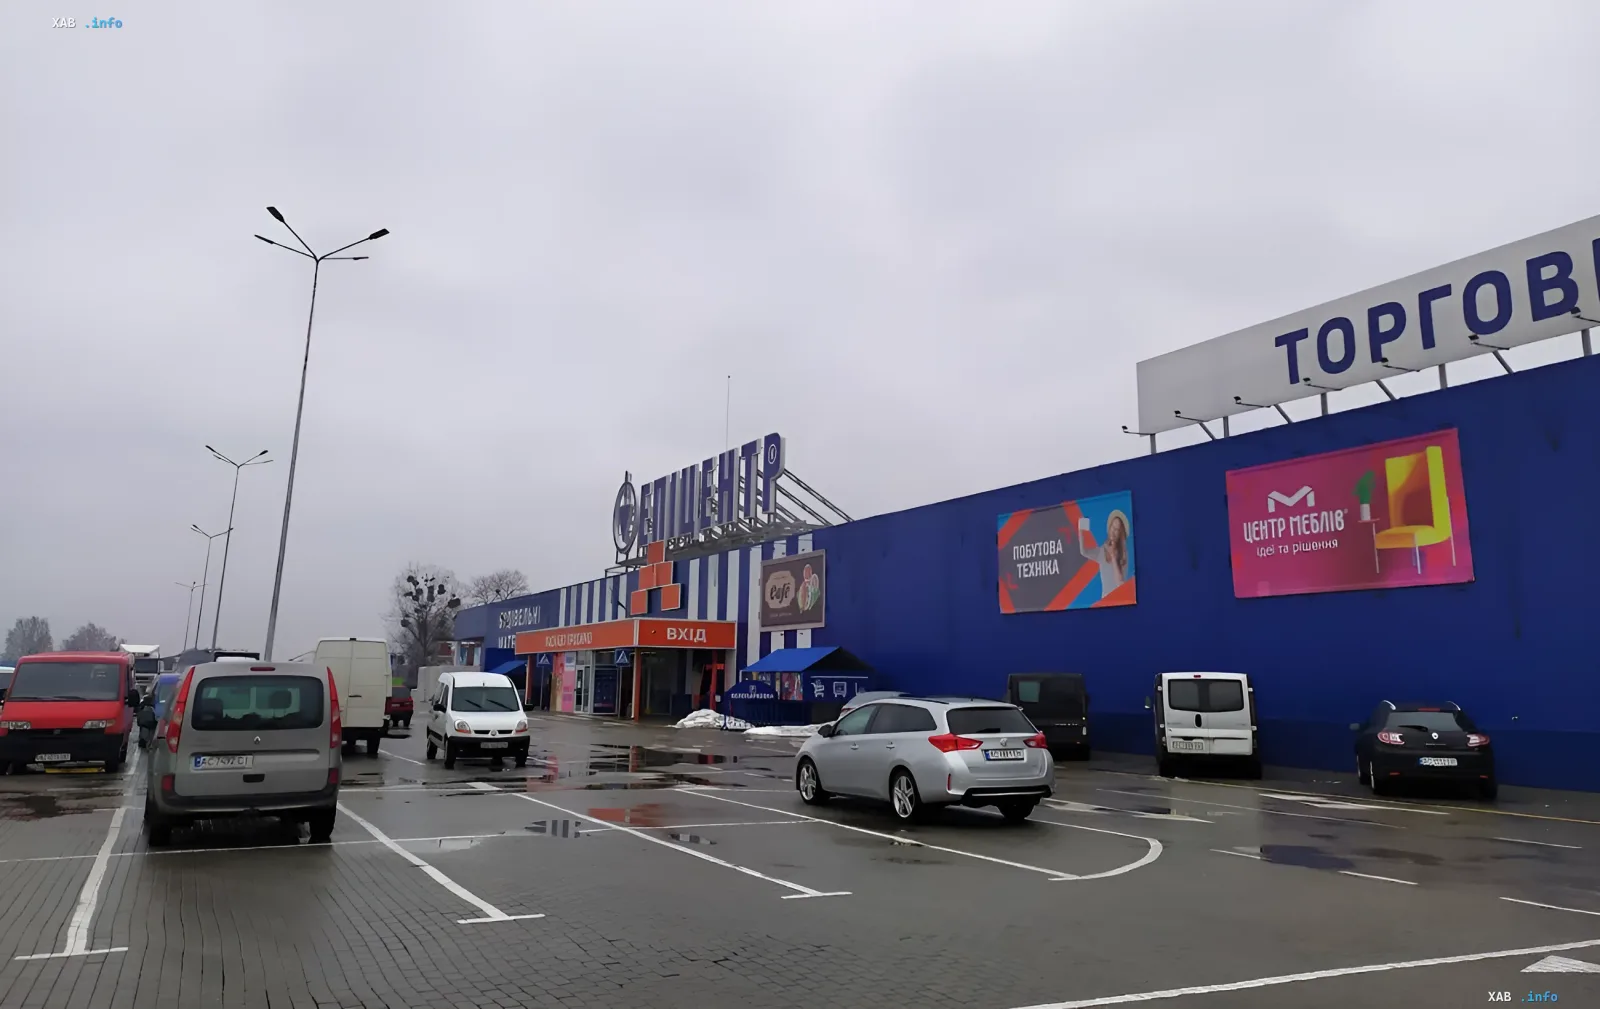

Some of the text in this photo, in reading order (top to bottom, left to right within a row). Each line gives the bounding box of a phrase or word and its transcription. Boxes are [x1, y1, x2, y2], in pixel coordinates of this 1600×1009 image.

[638, 432, 785, 547] ЕПІЦЕНТР
[1243, 509, 1345, 543] ЦЕНТР МЕБЛІВ
[1013, 539, 1063, 560] ПОБУТОВА
[1278, 545, 1289, 554] та
[1292, 539, 1338, 555] рішення
[1016, 559, 1060, 578] ТЕХНІКА
[667, 627, 707, 643] ВХІД
